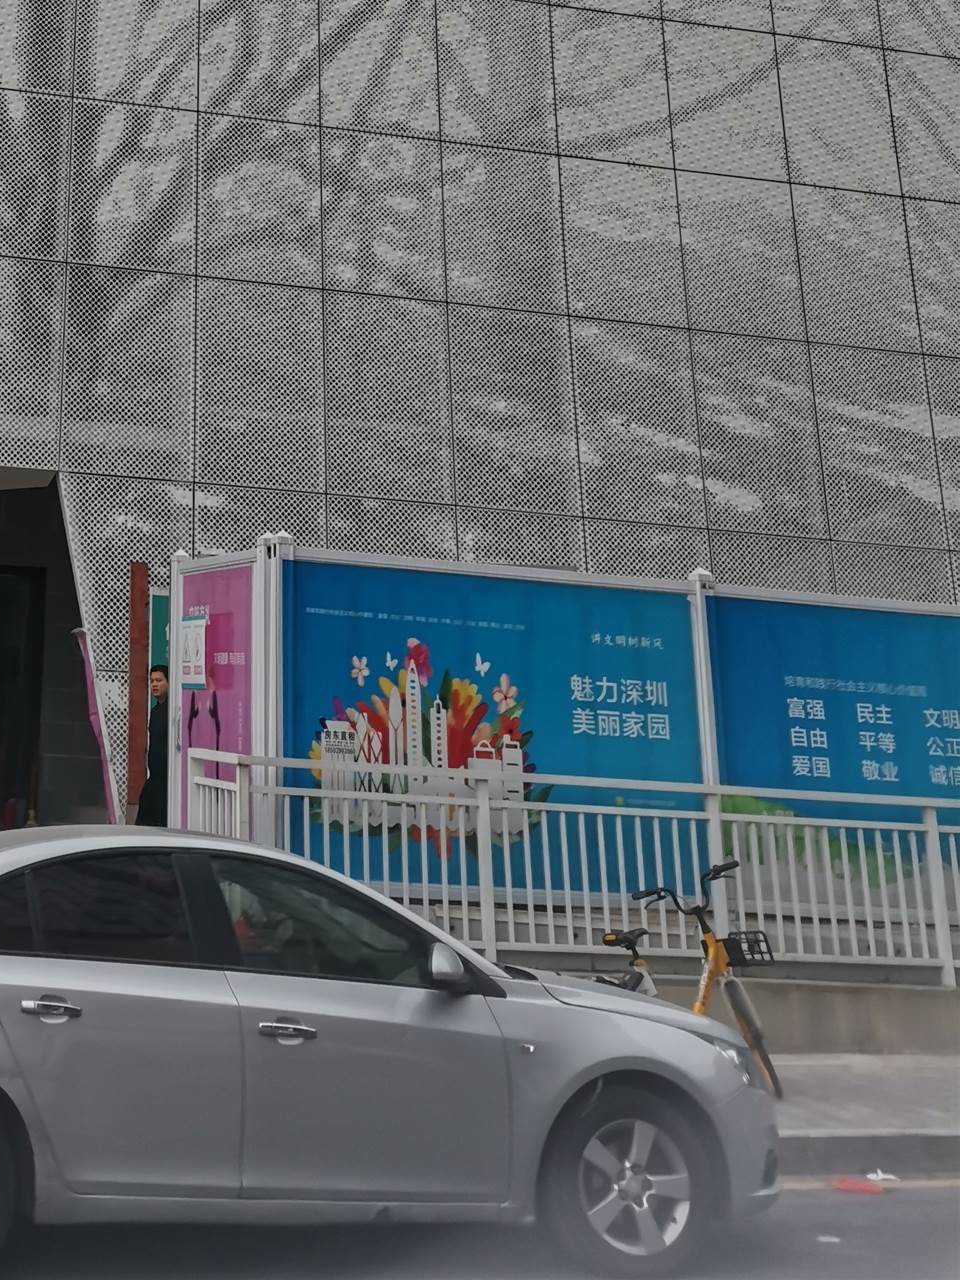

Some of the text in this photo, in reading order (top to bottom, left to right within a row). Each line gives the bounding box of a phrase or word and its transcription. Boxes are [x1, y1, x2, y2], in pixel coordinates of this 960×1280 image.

[570, 674, 669, 707] 魅力深圳
[571, 707, 671, 740] 美丽家园
[787, 697, 960, 730] 富强 民主 文明
[790, 726, 960, 758] 自由 平等 公正
[792, 755, 960, 786] 爱国 敬业 诚信
